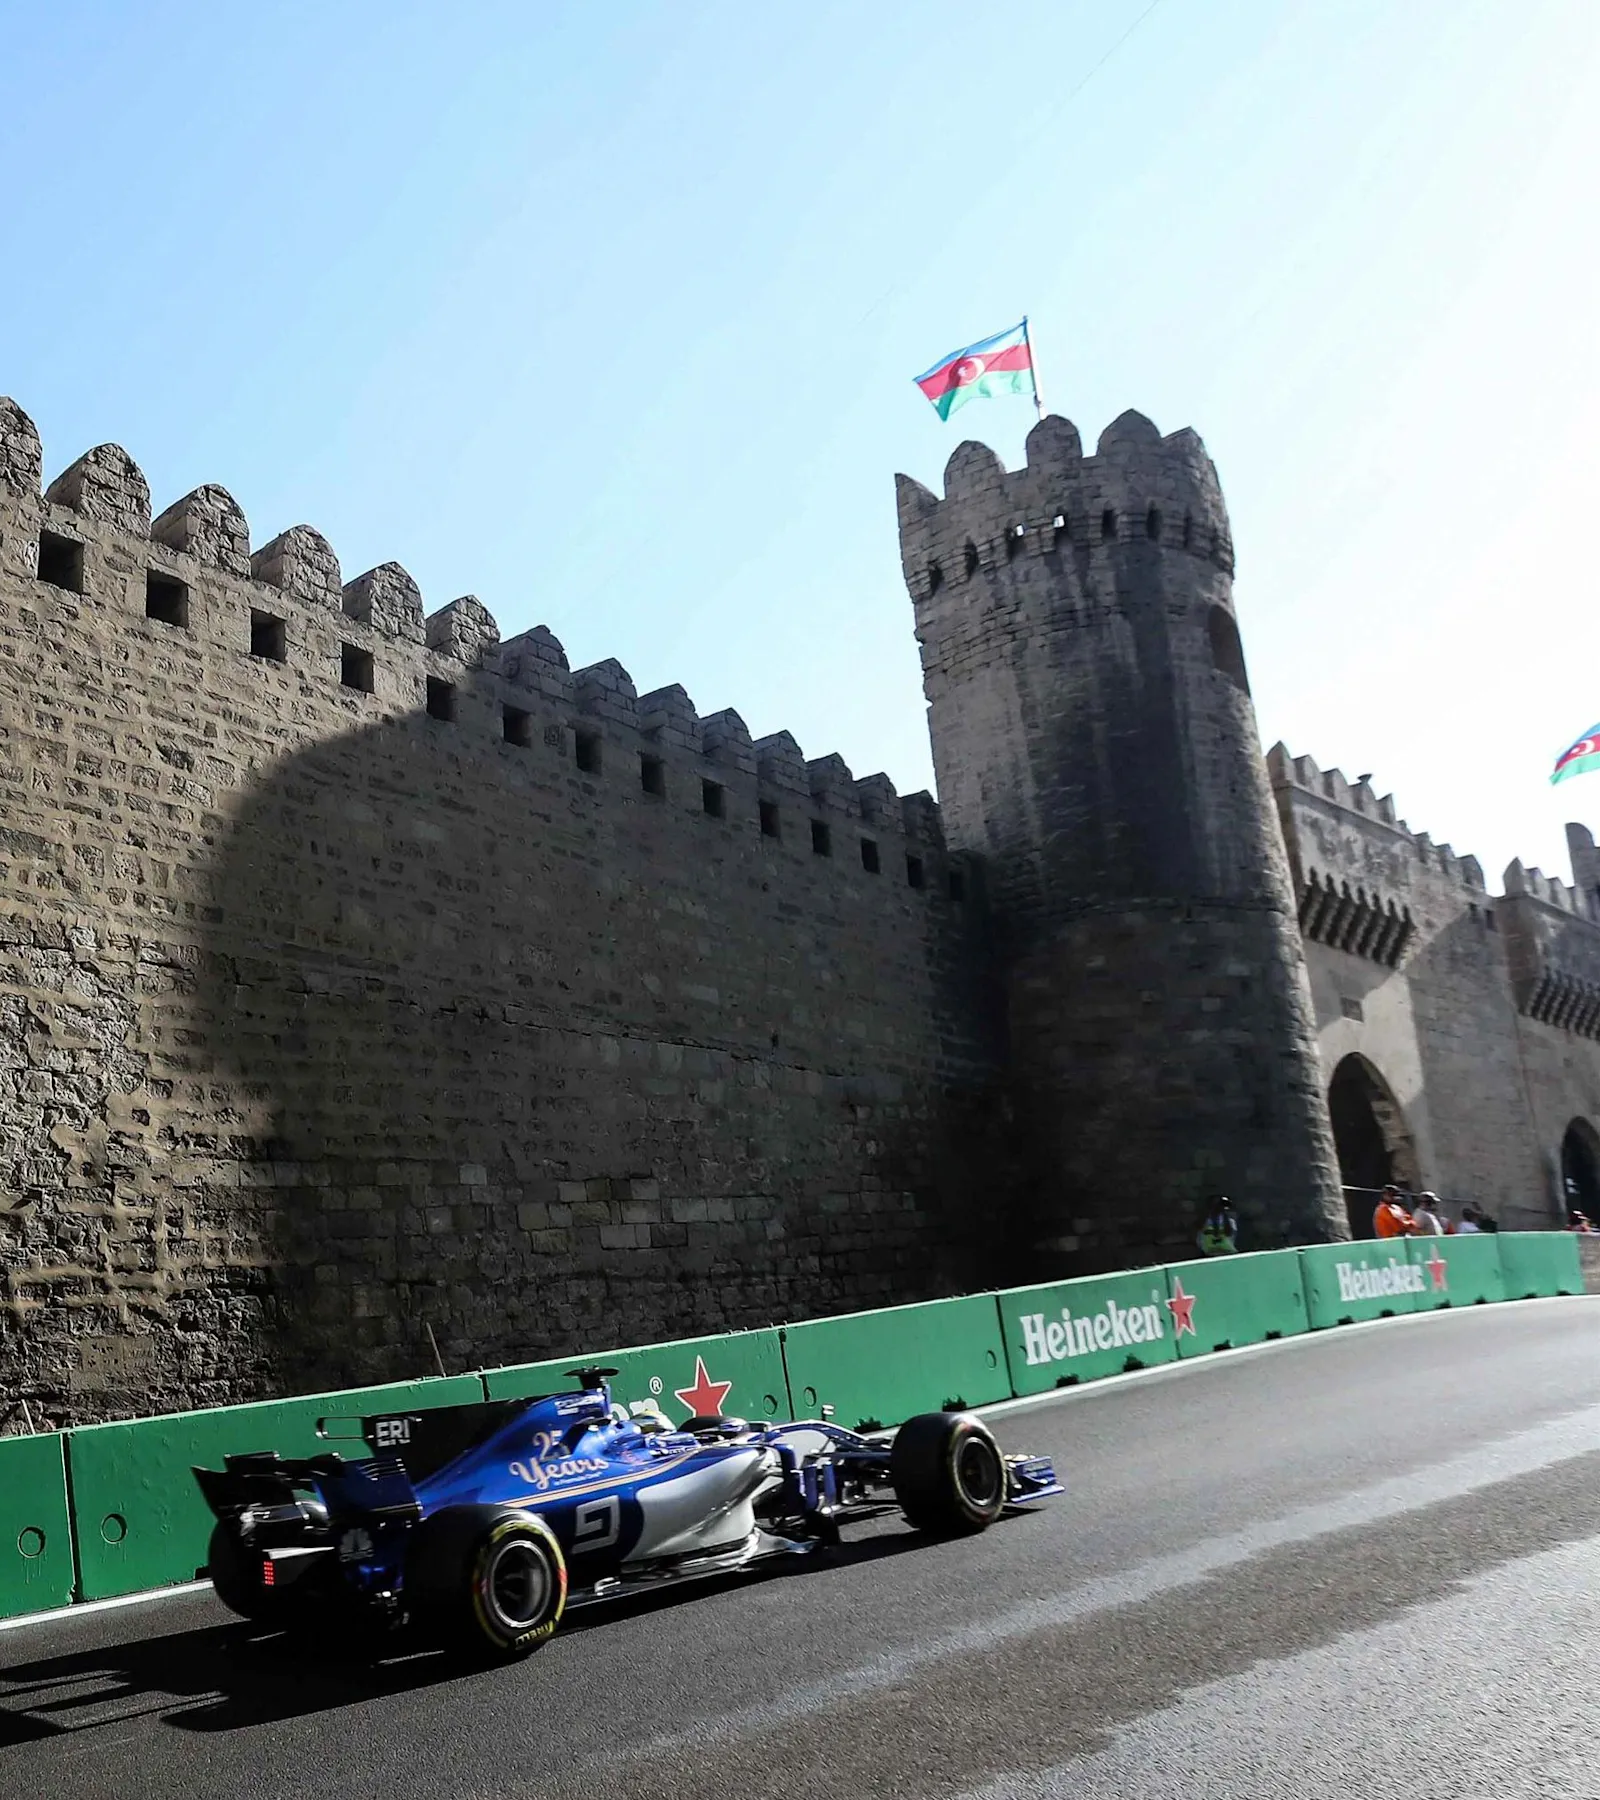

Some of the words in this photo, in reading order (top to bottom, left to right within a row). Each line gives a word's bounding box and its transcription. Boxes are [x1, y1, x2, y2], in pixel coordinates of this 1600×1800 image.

[1019, 1300, 1164, 1366] Heineken
[375, 1420, 411, 1439] ERI
[531, 1430, 571, 1461] 25
[508, 1457, 609, 1490] Years
